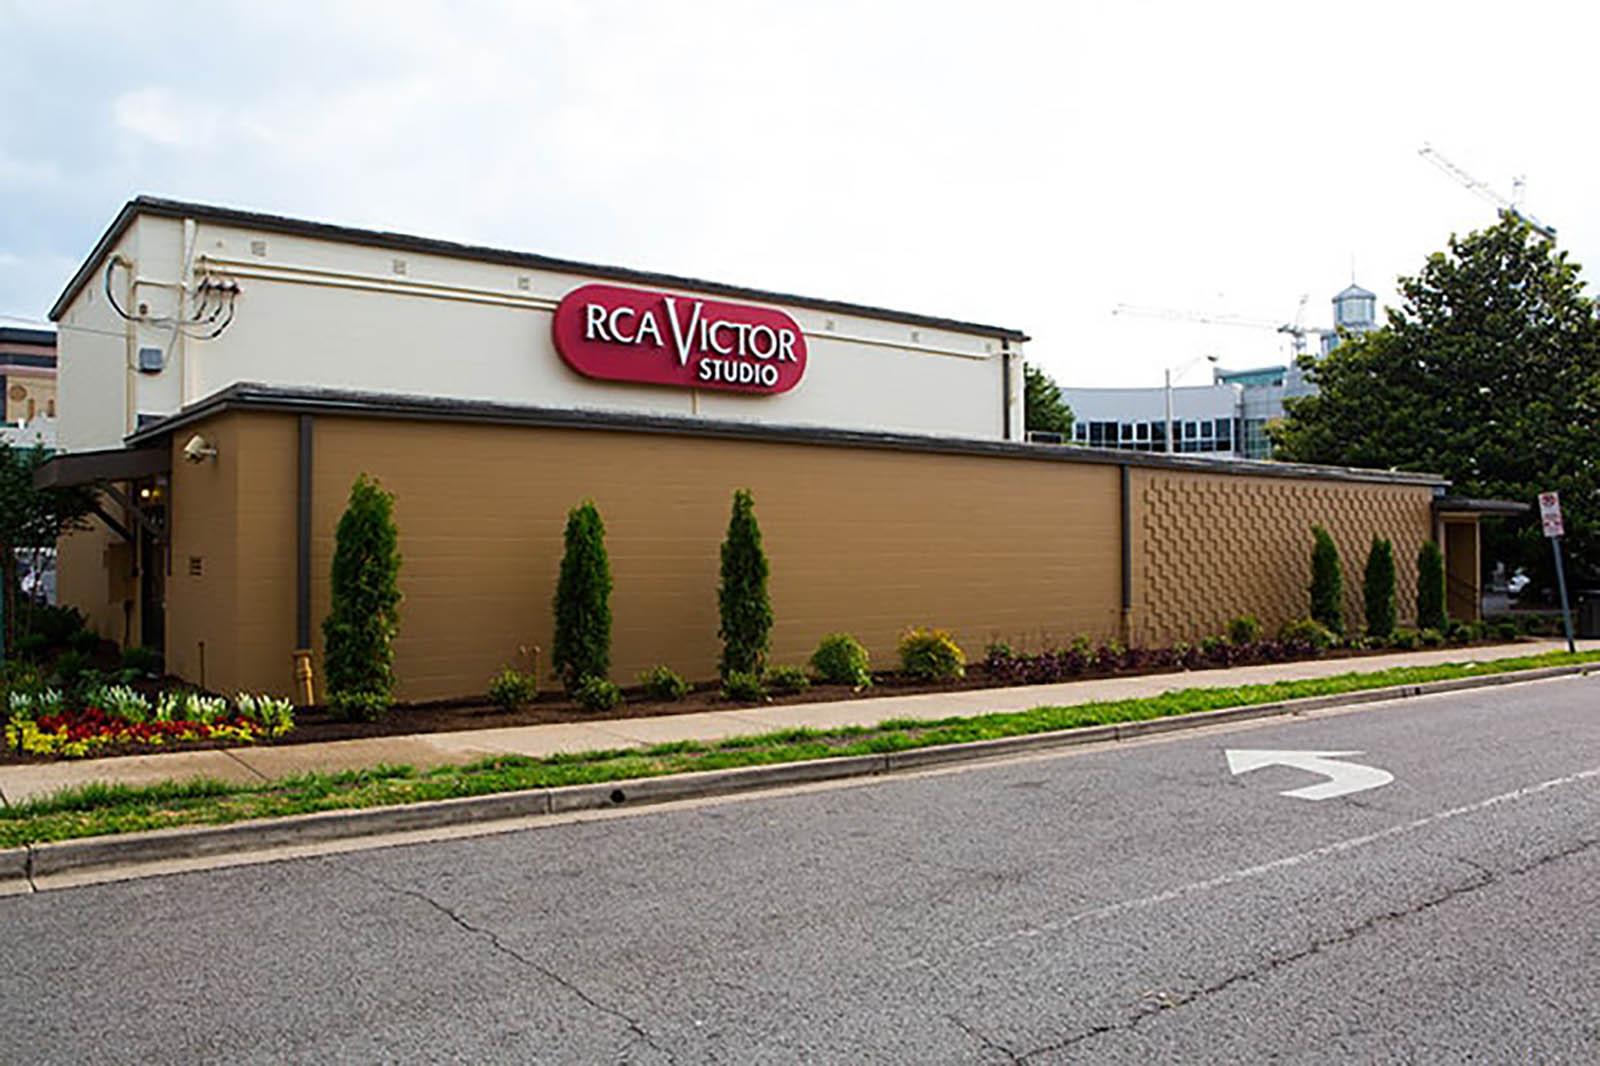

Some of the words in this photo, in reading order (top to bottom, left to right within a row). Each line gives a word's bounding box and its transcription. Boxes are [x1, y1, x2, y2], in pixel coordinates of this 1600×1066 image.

[586, 303, 664, 347] RCA
[664, 297, 797, 366] VICTOR
[699, 358, 778, 386] STUDIO
